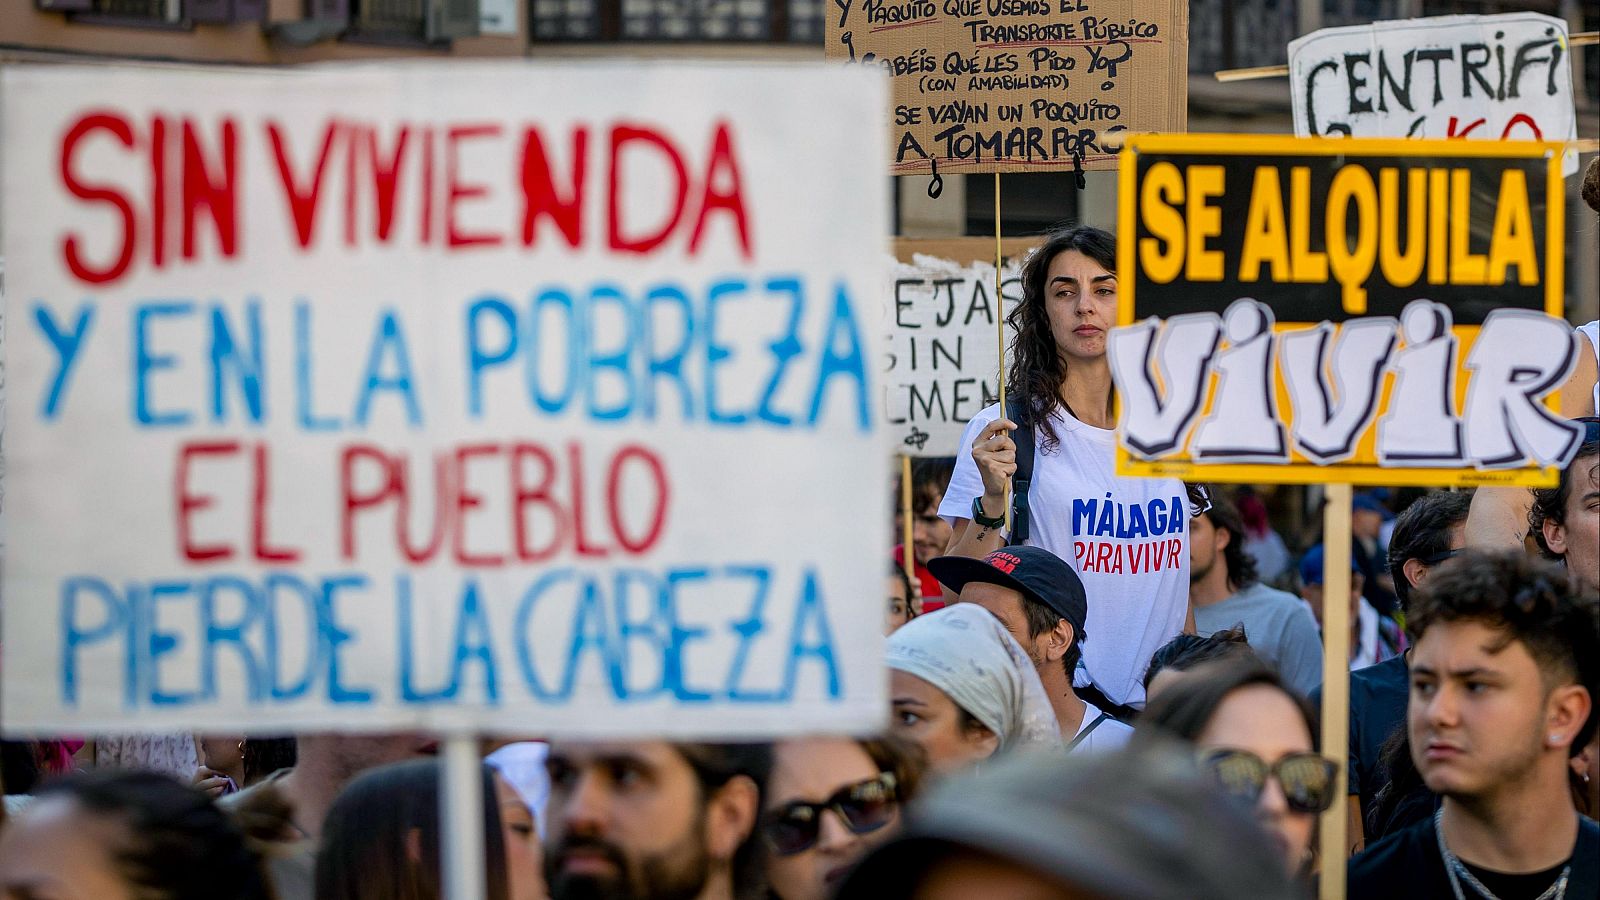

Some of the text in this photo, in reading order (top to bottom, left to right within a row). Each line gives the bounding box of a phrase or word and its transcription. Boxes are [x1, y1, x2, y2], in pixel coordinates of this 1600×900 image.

[835, 0, 854, 28] Y
[943, 0, 983, 18] QUE
[986, 0, 1051, 17] USEMOS
[1060, 0, 1089, 14] EL
[963, 20, 1077, 43] TRANSPORTE
[943, 50, 981, 76] QUÉ
[984, 52, 1019, 73] LES
[919, 75, 957, 92] (CON
[895, 105, 922, 126] SE
[928, 100, 988, 124] VAYAN
[998, 102, 1023, 122] UN
[896, 131, 929, 162] A
[934, 124, 1048, 163] TOMAR
[1052, 127, 1100, 161] POR
[59, 111, 754, 287] SIN VIVIENDA
[1140, 162, 1540, 315] SE ALQUILA
[32, 276, 872, 432] Y EN LA POBREZA
[178, 443, 668, 566] EL PUEBLO
[1072, 492, 1184, 539] MÁLAGA
[1074, 539, 1182, 575] PARA VIVIR
[62, 567, 842, 708] PIERDE LA CABEZA
